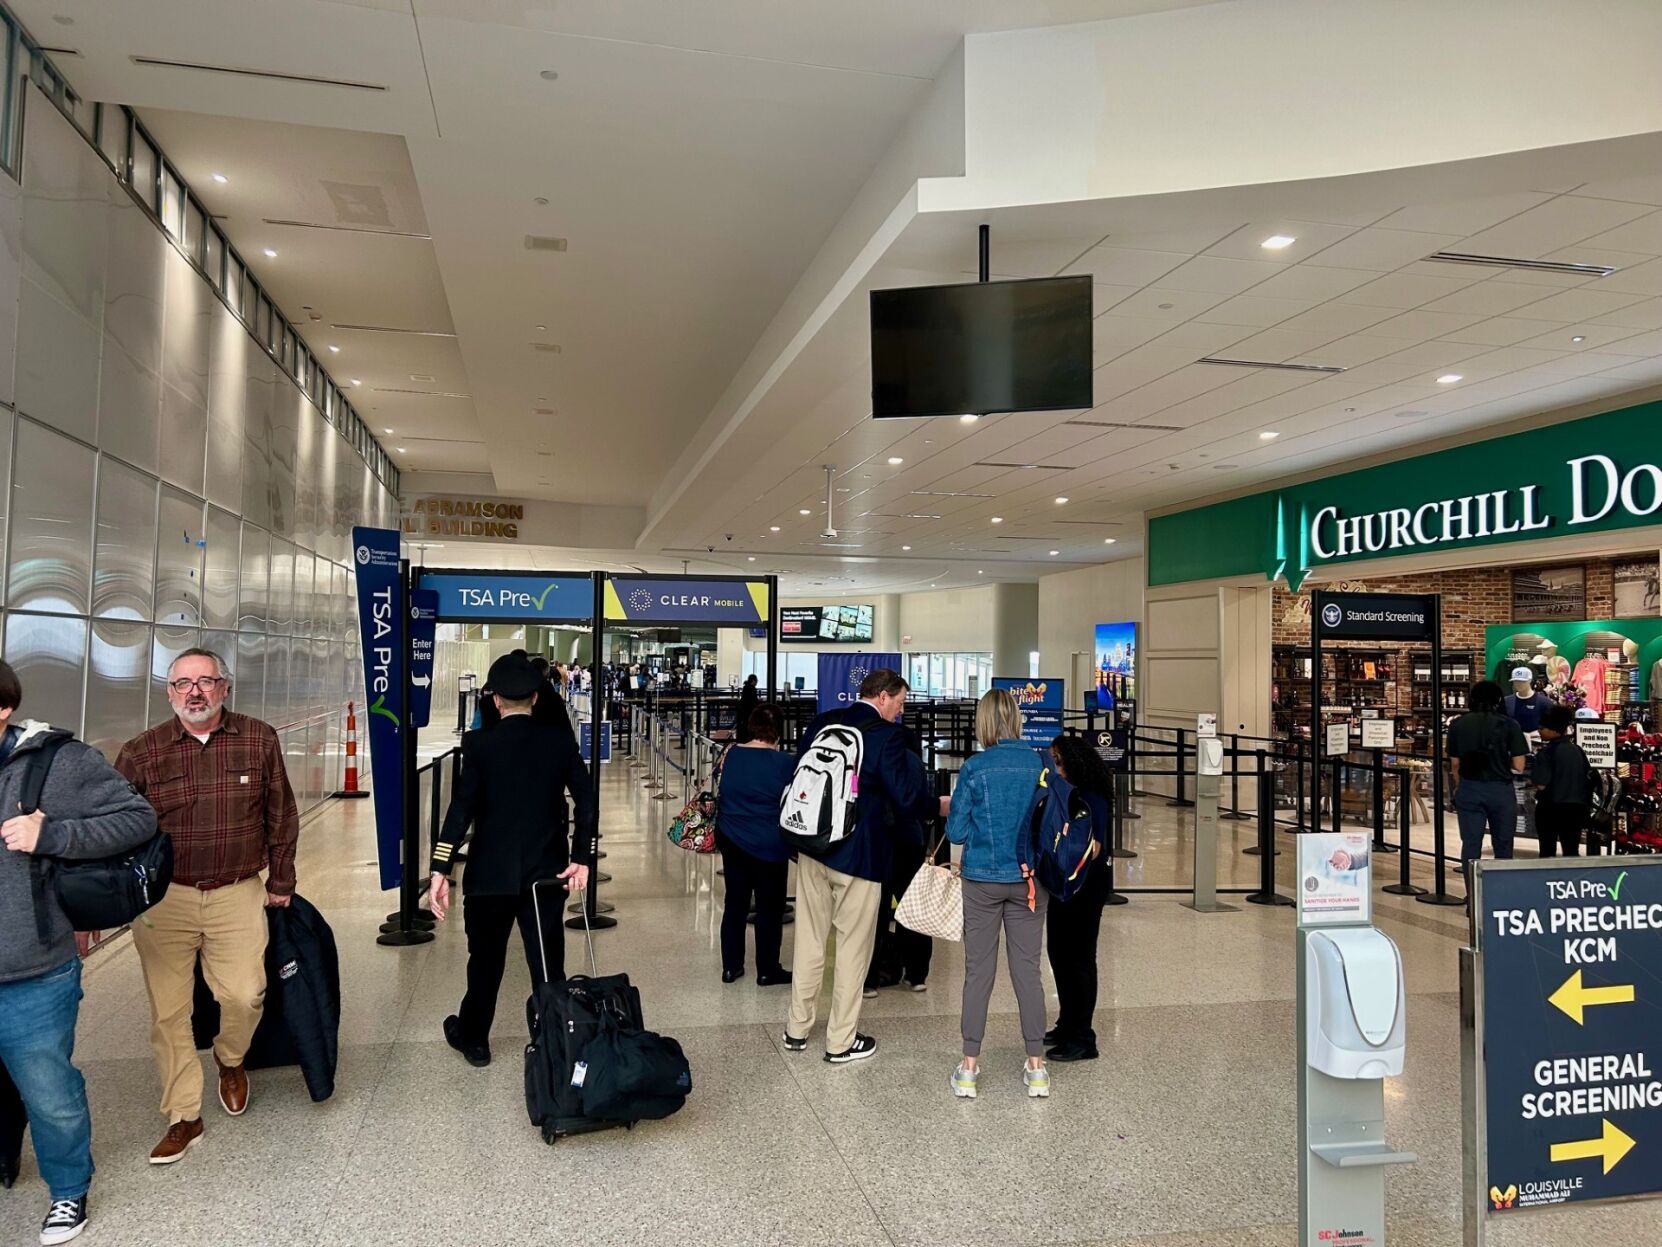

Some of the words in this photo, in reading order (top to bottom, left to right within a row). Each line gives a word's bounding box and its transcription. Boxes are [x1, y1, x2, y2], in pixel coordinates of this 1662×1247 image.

[412, 499, 524, 520] ABRAMSON
[430, 519, 518, 539] BUILDING
[1311, 484, 1549, 559] CHURCHILL
[458, 588, 494, 606] TSA
[499, 589, 531, 607] Pre
[660, 595, 709, 606] CLEAR
[714, 599, 744, 607] MOBILE
[373, 586, 392, 640] TSA
[1346, 610, 1384, 622] Standard
[1385, 611, 1425, 624] Screening
[412, 638, 432, 649] Enter
[413, 650, 432, 660] Here
[373, 647, 392, 693] Pre
[837, 692, 861, 702] CLE
[1010, 686, 1028, 696] bite
[1017, 694, 1045, 706] flight
[785, 820, 807, 831] adidas
[1546, 880, 1579, 900] TSA
[1579, 880, 1607, 899] Pre
[1492, 909, 1544, 937] TSA
[1550, 903, 1662, 935] PRECHEC
[1563, 936, 1618, 965] KCM
[1533, 1052, 1652, 1087] GENERAL
[1521, 1080, 1662, 1120] SCREENING
[1518, 1176, 1584, 1195] LOUISVILLE
[1518, 1190, 1560, 1202] MUHAMMAD
[1559, 1189, 1571, 1198] ALI
[1332, 1228, 1364, 1240] Johnson
